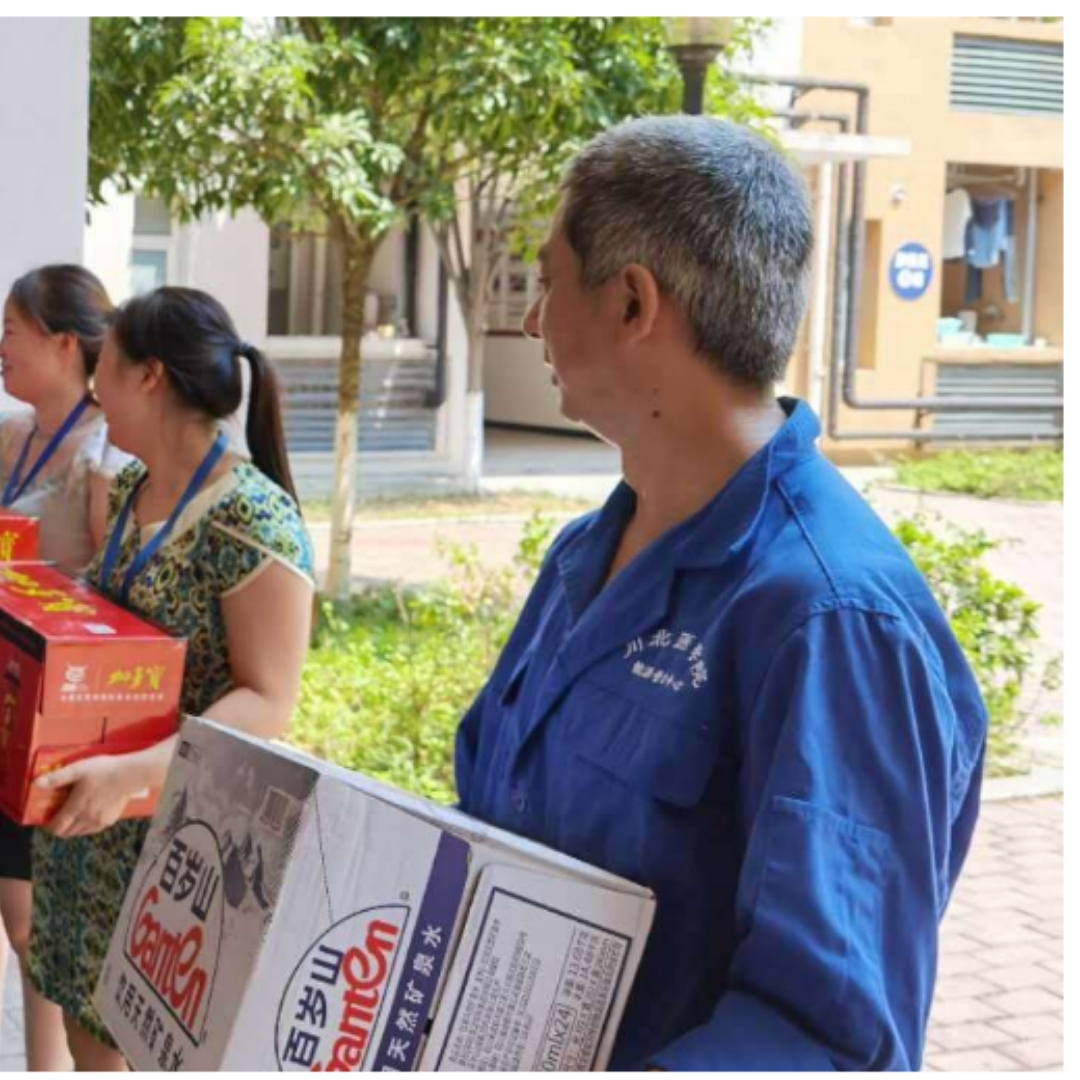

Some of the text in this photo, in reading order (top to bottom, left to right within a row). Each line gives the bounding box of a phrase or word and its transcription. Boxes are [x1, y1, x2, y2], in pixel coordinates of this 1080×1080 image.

[159, 838, 221, 922] 百岁山
[130, 884, 208, 1030] Ganten
[282, 943, 345, 1068] 百岁山
[310, 918, 400, 1071] anten
[382, 924, 443, 1071] 天然矿泉水
